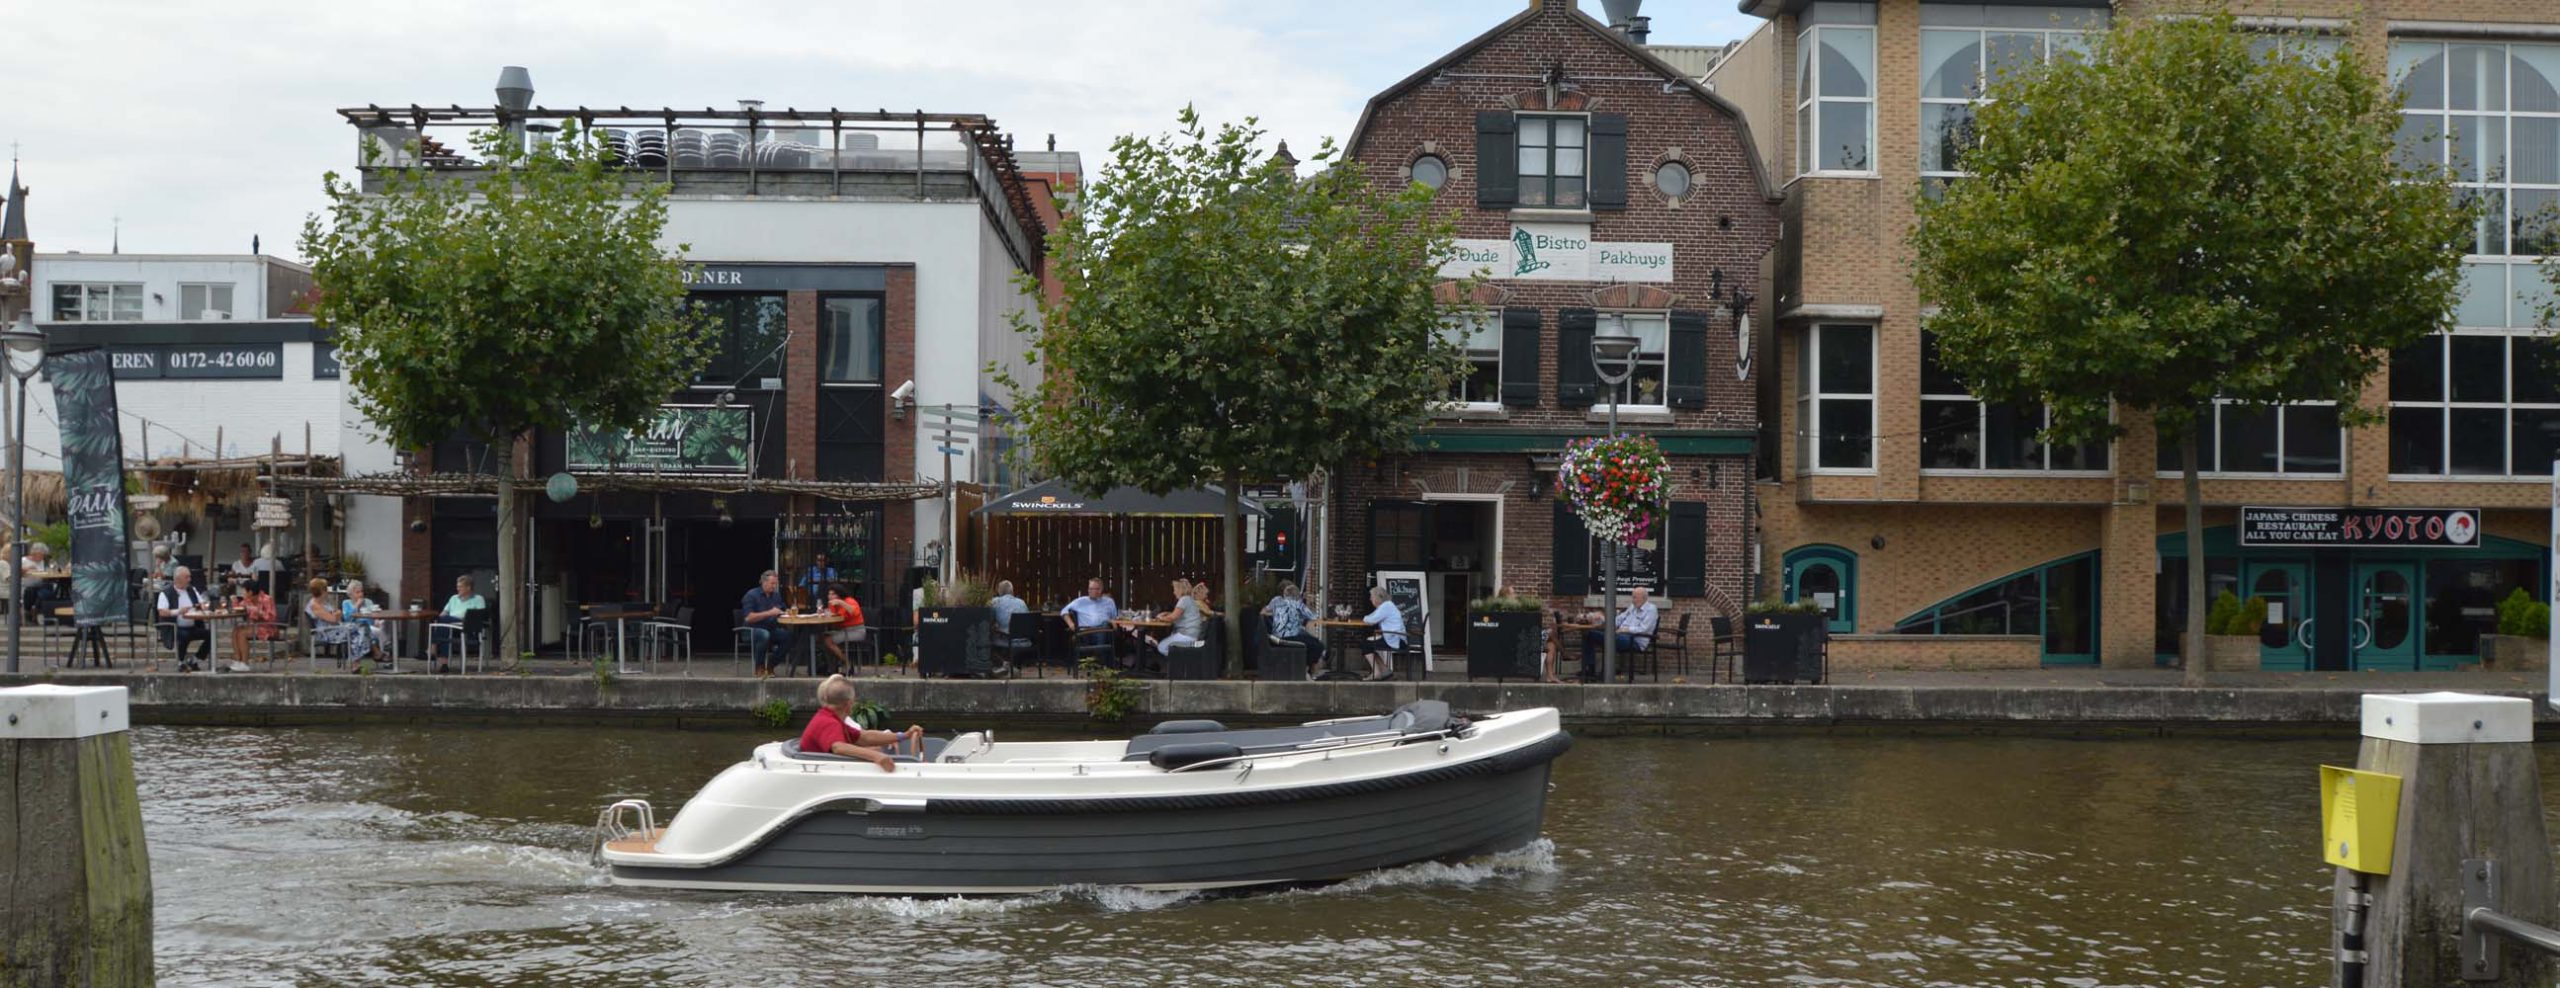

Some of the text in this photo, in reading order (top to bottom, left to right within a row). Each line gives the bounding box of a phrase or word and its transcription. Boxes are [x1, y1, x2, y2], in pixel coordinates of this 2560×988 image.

[1536, 235, 1587, 250] Bistro
[1459, 248, 1499, 263] Oude
[1600, 251, 1667, 268] Pakhuys
[682, 271, 742, 284] DNER
[68, 490, 120, 515] DAAN
[2292, 513, 2338, 522] CHINESE
[2257, 522, 2327, 531] RESTAURANT
[2341, 515, 2445, 540] KYOTO
[2245, 531, 2338, 540] ALL YOU CAN EAT
